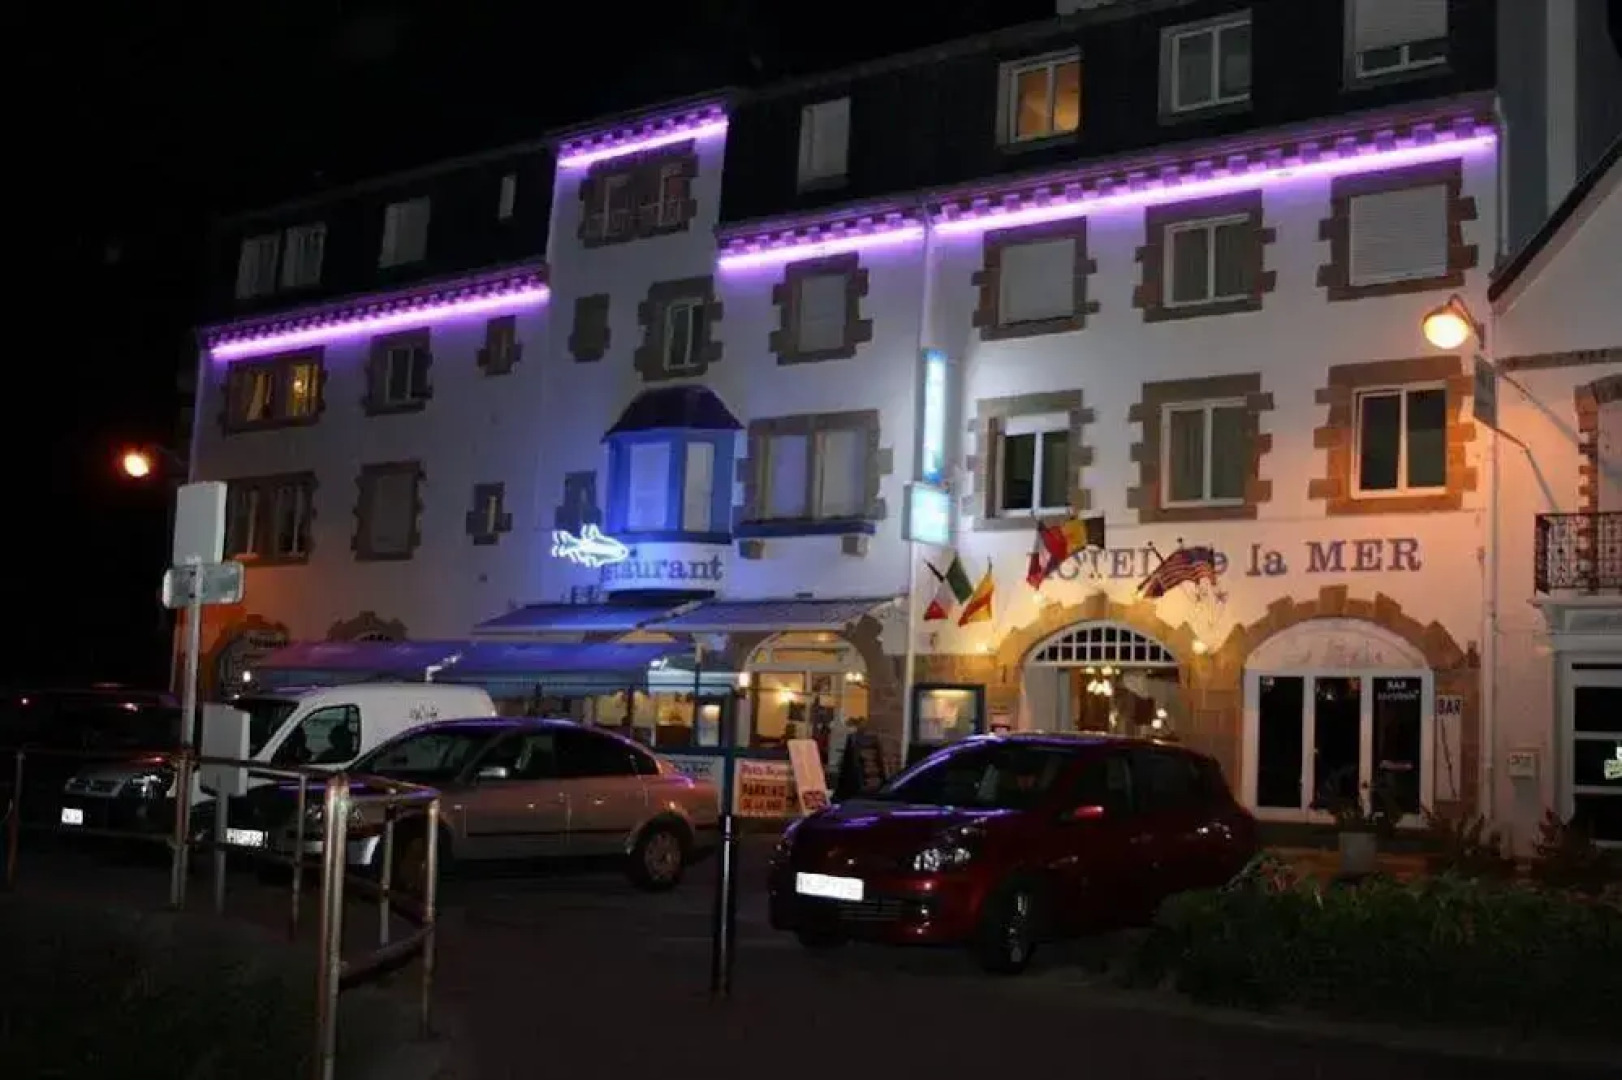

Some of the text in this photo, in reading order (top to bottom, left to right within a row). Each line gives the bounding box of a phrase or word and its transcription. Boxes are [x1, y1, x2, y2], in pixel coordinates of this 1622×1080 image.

[1246, 543, 1288, 577] la
[1304, 537, 1422, 573] MER
[1437, 698, 1461, 716] BAR
